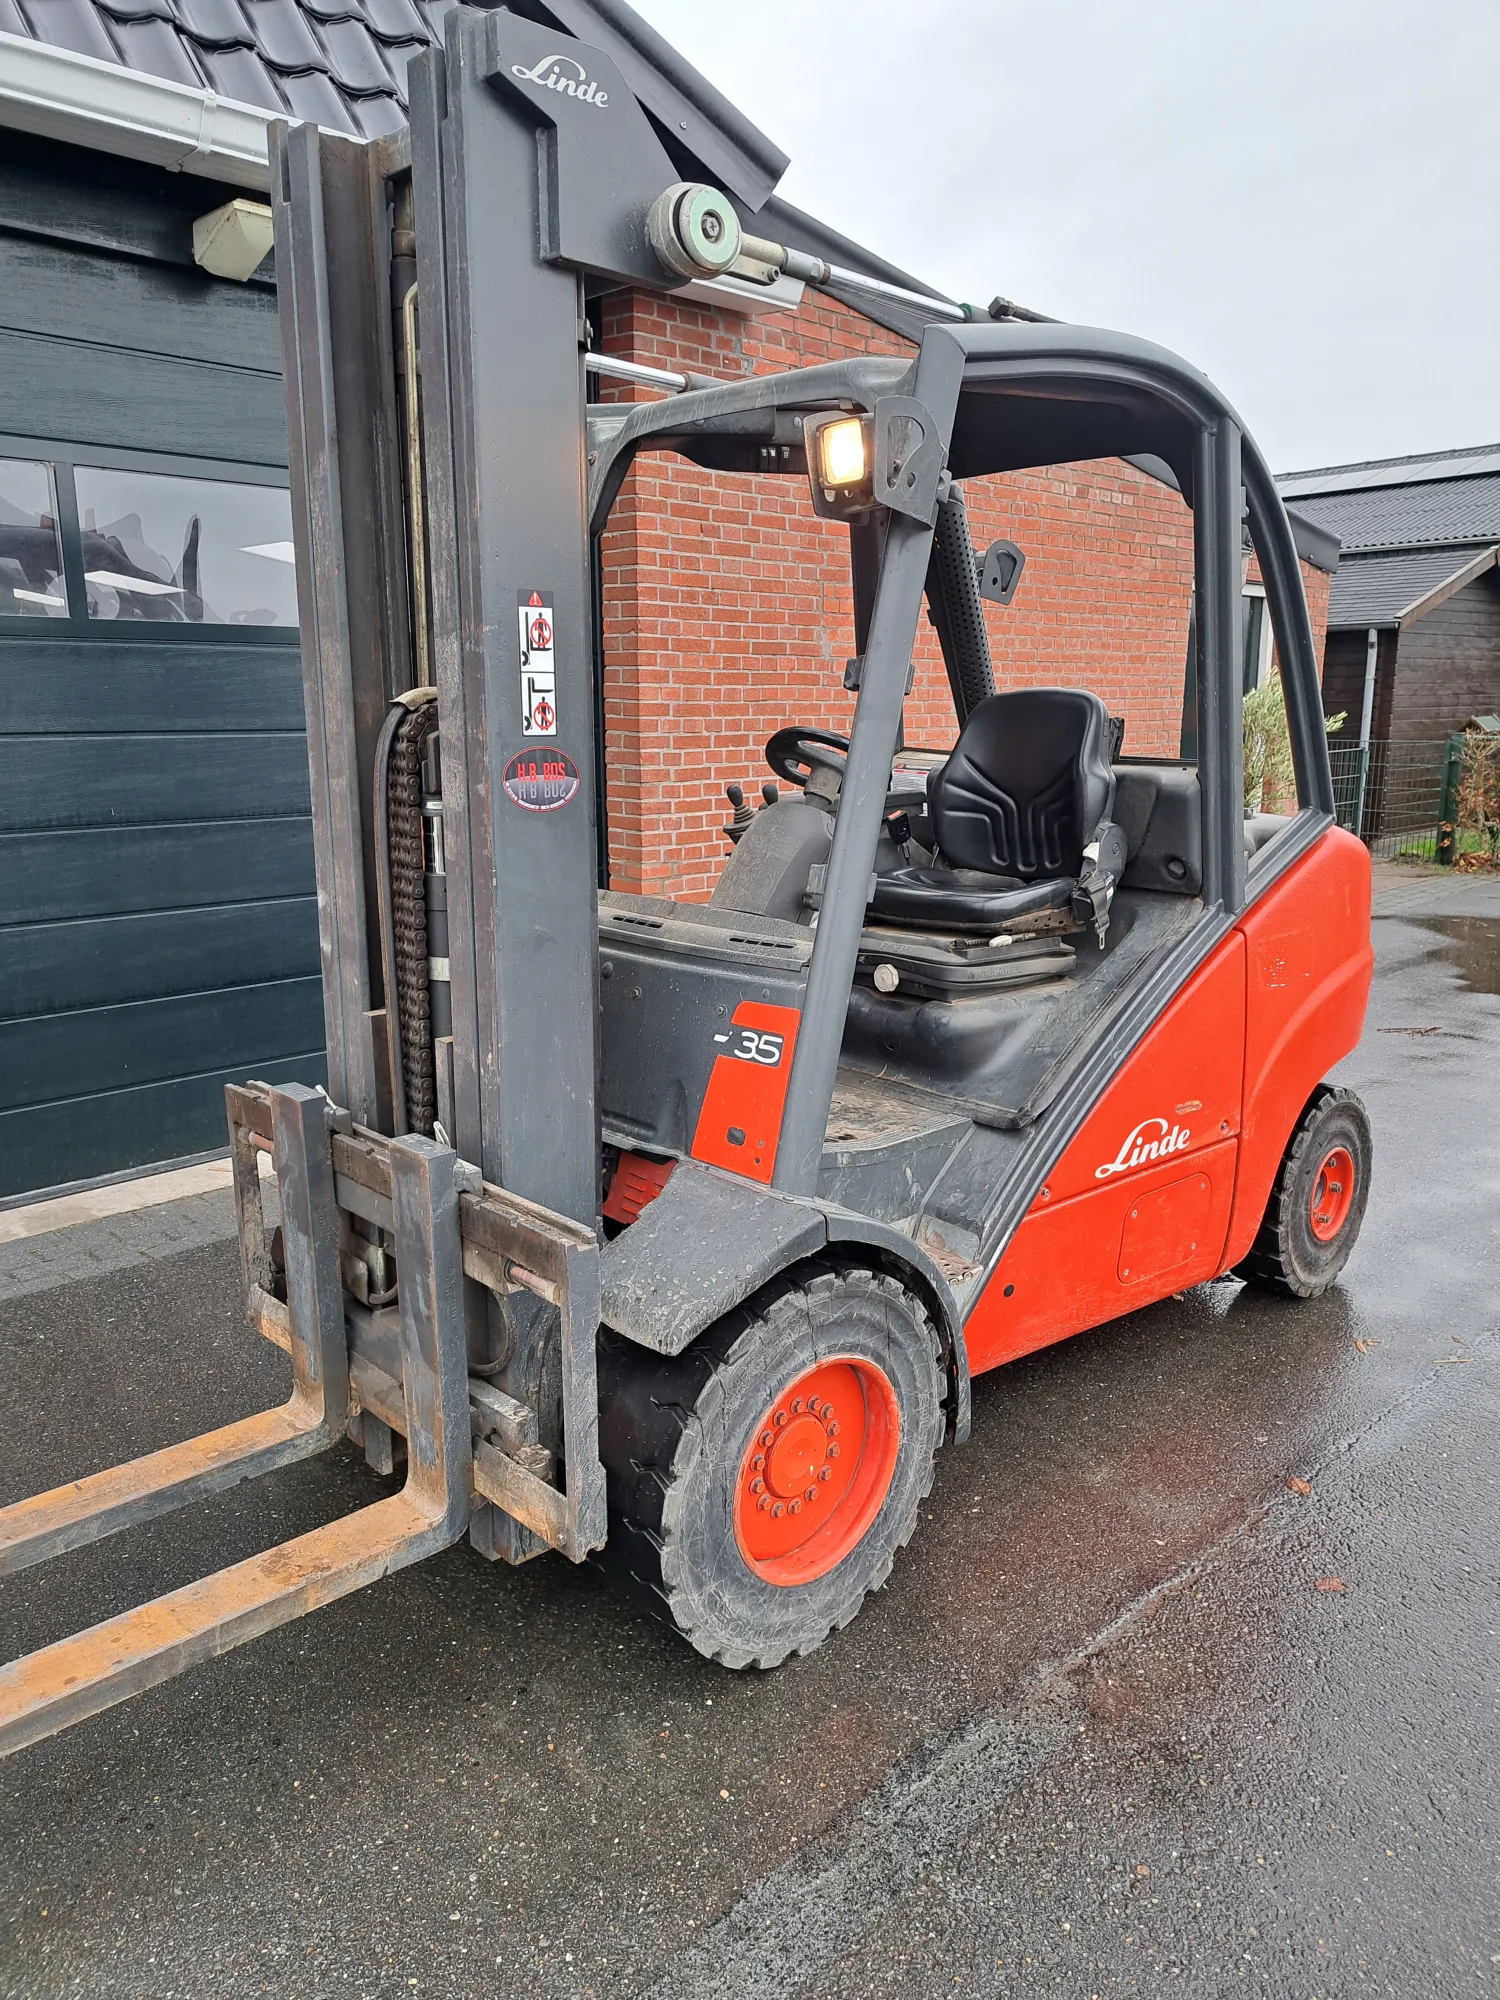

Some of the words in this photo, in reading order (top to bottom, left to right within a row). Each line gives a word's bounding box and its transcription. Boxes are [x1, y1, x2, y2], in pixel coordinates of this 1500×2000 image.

[511, 54, 608, 108] Linde
[542, 762, 566, 781] BOS
[734, 1030, 783, 1064] 35
[1095, 1117, 1190, 1179] Linde
